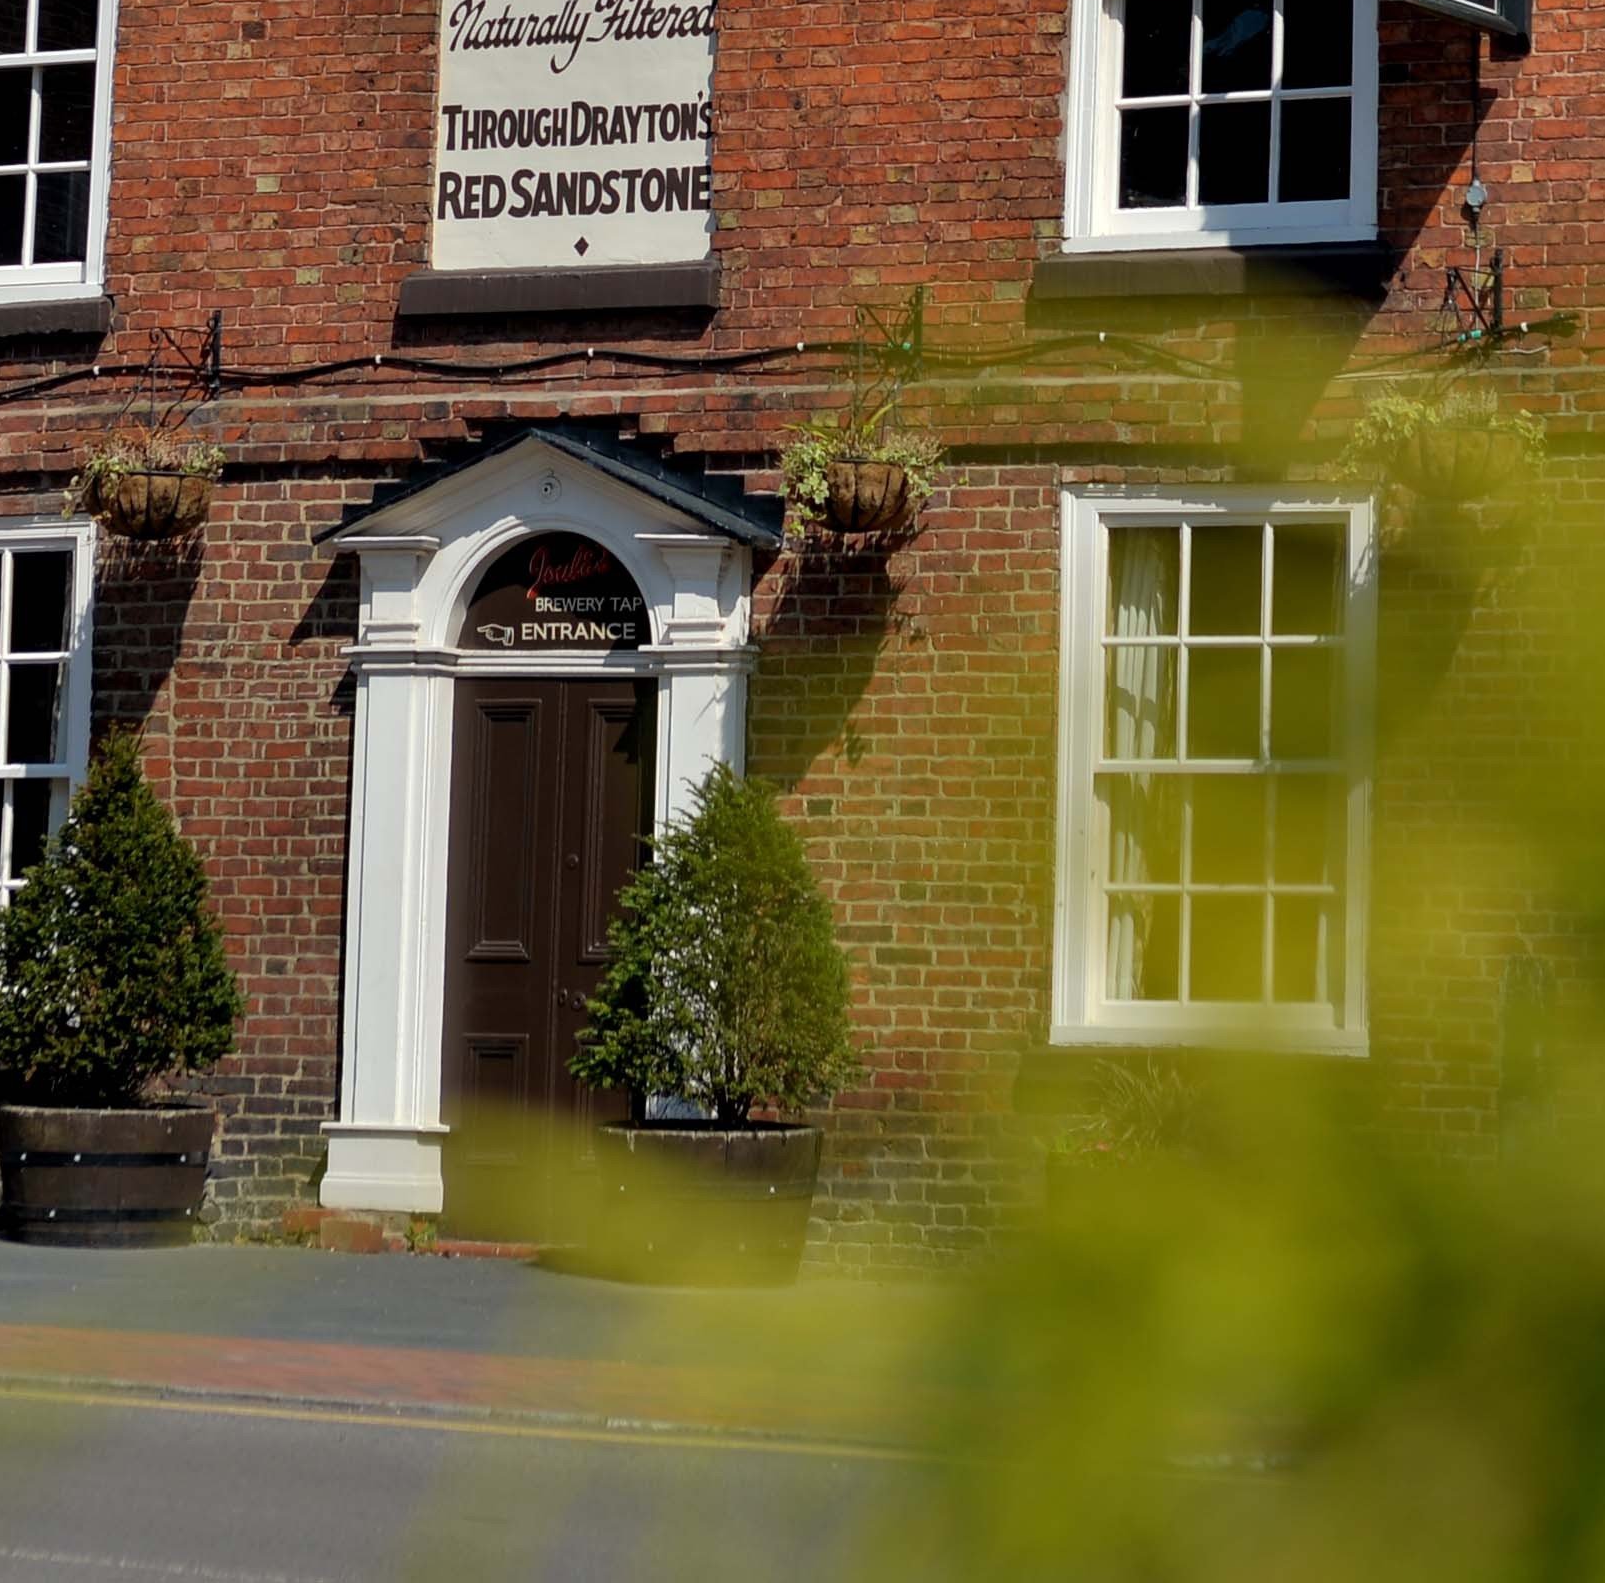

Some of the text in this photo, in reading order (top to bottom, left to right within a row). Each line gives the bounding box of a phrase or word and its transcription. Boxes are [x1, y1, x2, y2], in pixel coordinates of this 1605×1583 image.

[442, 90, 714, 152] THROUGH DRAYTON'S
[437, 166, 712, 220] RED SANDSTONE
[535, 596, 643, 613] BREWERY TAP
[521, 622, 637, 641] ENTRANCE
